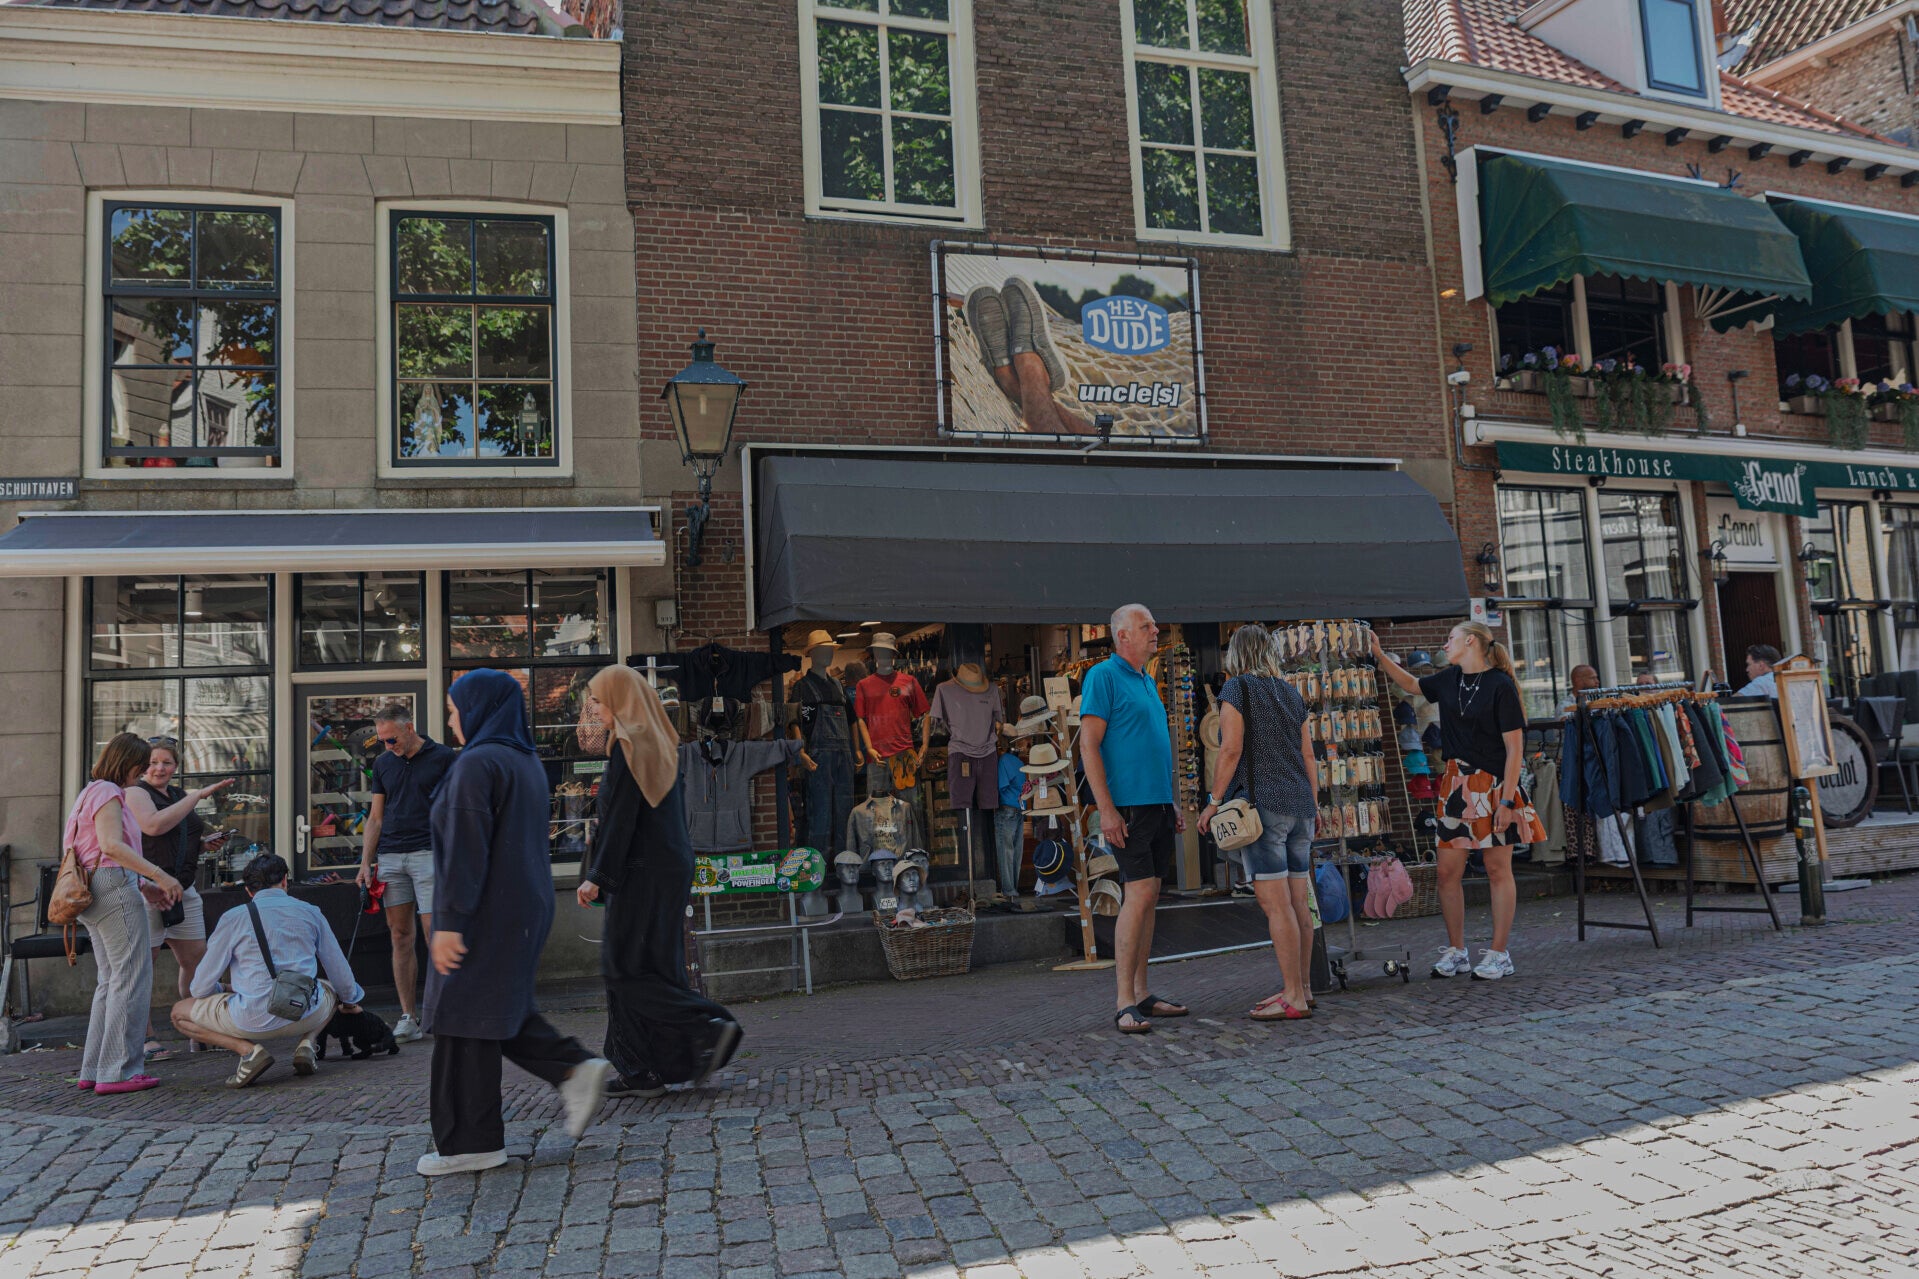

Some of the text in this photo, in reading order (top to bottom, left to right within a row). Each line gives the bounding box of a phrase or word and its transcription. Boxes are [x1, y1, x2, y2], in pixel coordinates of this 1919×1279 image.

[1107, 299, 1147, 319] HEY
[1087, 308, 1164, 350] DUDE
[1078, 382, 1182, 408] uncle[s]
[1551, 446, 1675, 478] Steakhouse
[0, 482, 73, 496] SCHUITHAVEN
[1742, 460, 1804, 506] Genot
[1847, 465, 1917, 489] Lunch &
[1719, 513, 1764, 547] Genot
